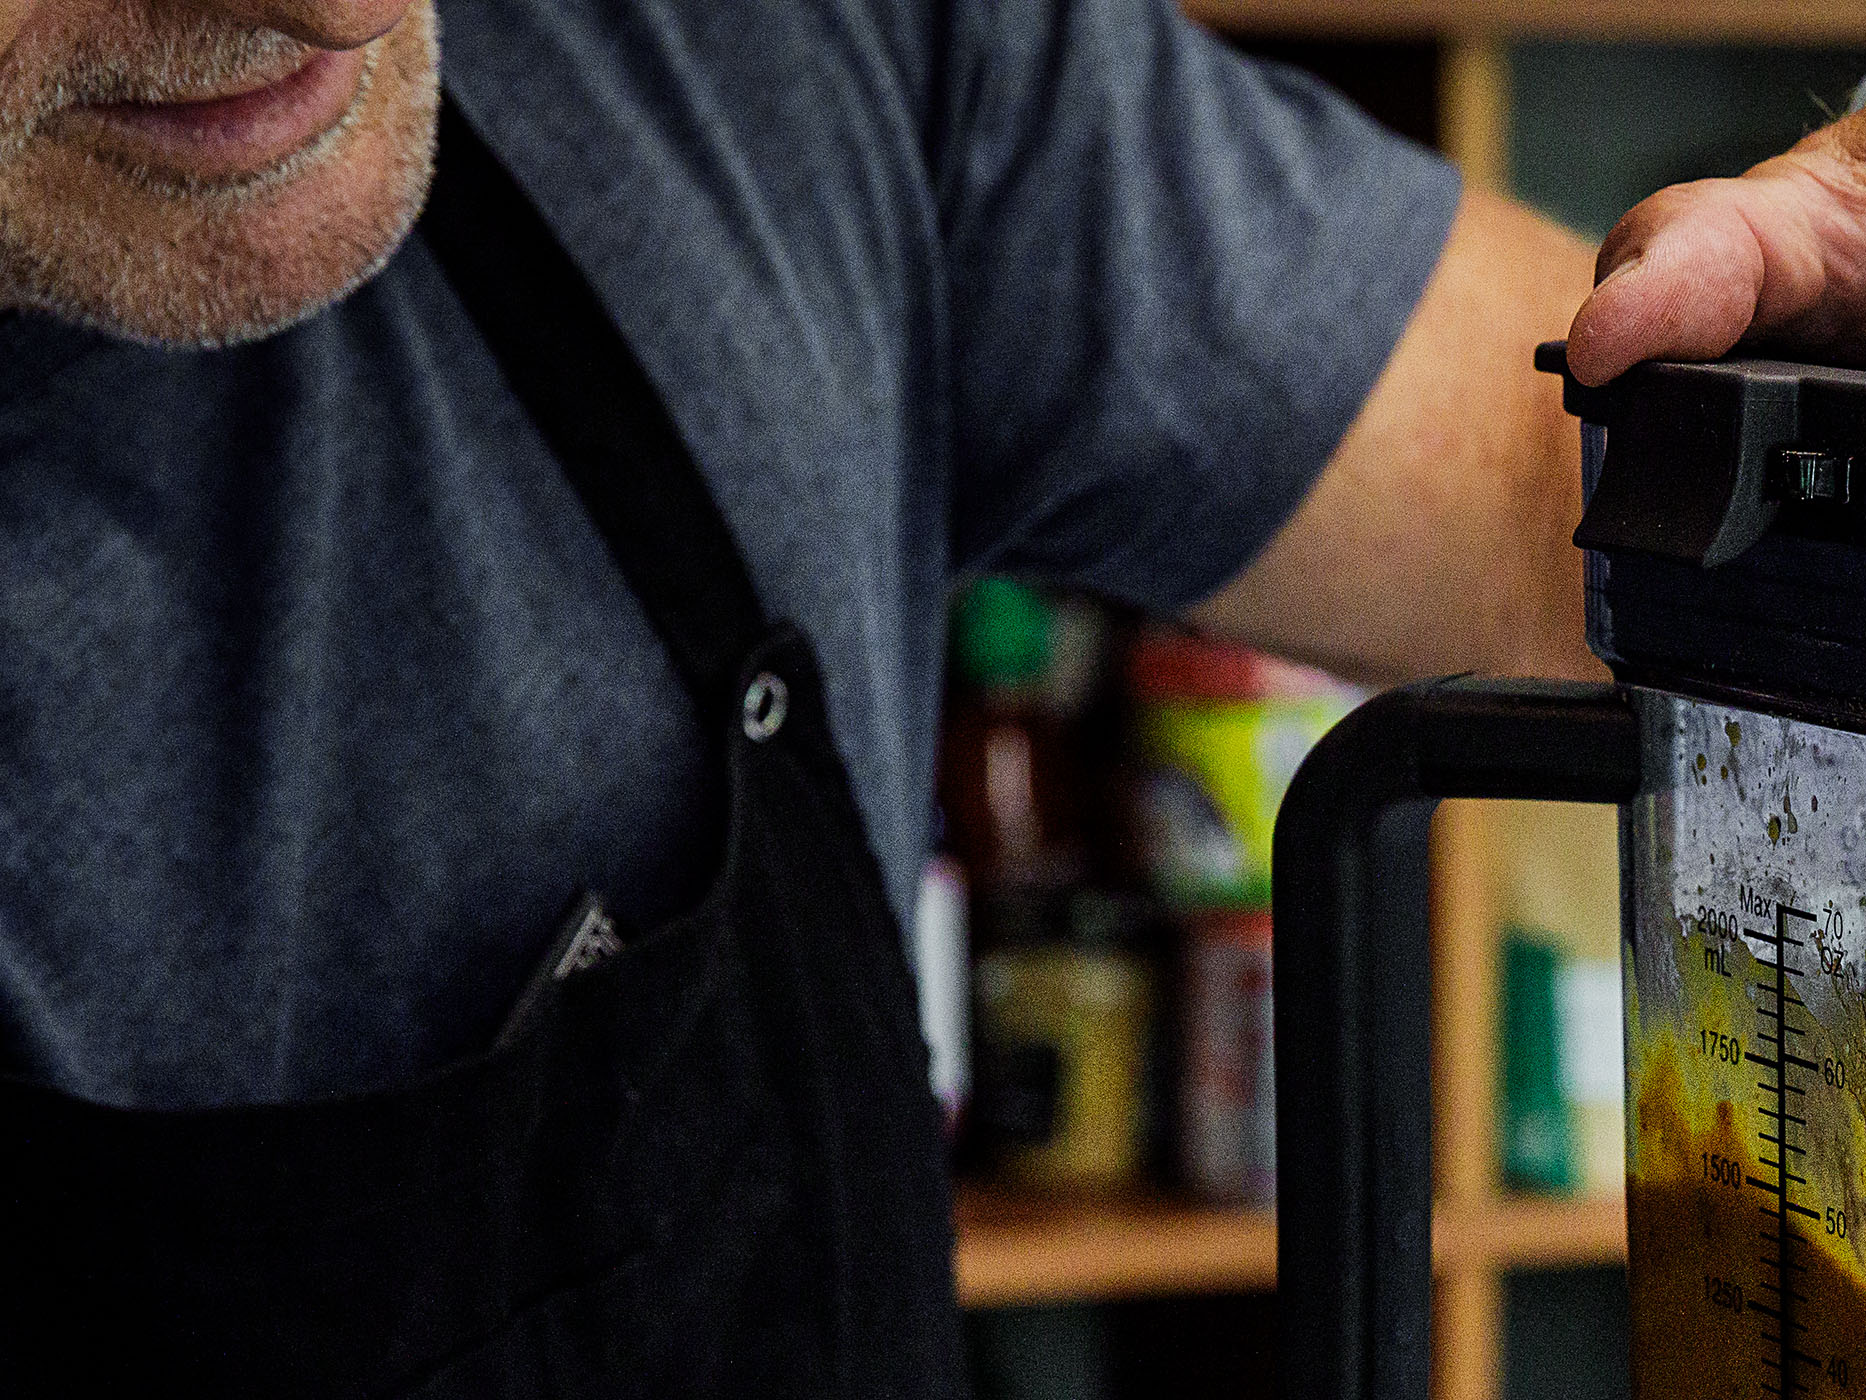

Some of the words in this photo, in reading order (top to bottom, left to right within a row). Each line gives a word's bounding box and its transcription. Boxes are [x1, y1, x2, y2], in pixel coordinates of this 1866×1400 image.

[1740, 883, 1772, 919] Max
[1698, 905, 1738, 942] 2000
[1823, 907, 1843, 940] 70
[1705, 944, 1732, 977] mL
[1700, 1029, 1740, 1065] 1750
[1824, 1057, 1845, 1089] 60
[1701, 1152, 1741, 1189] 1500
[1825, 1206, 1846, 1238] 50
[1703, 1275, 1743, 1313] 1250
[1826, 1355, 1849, 1388] 40
